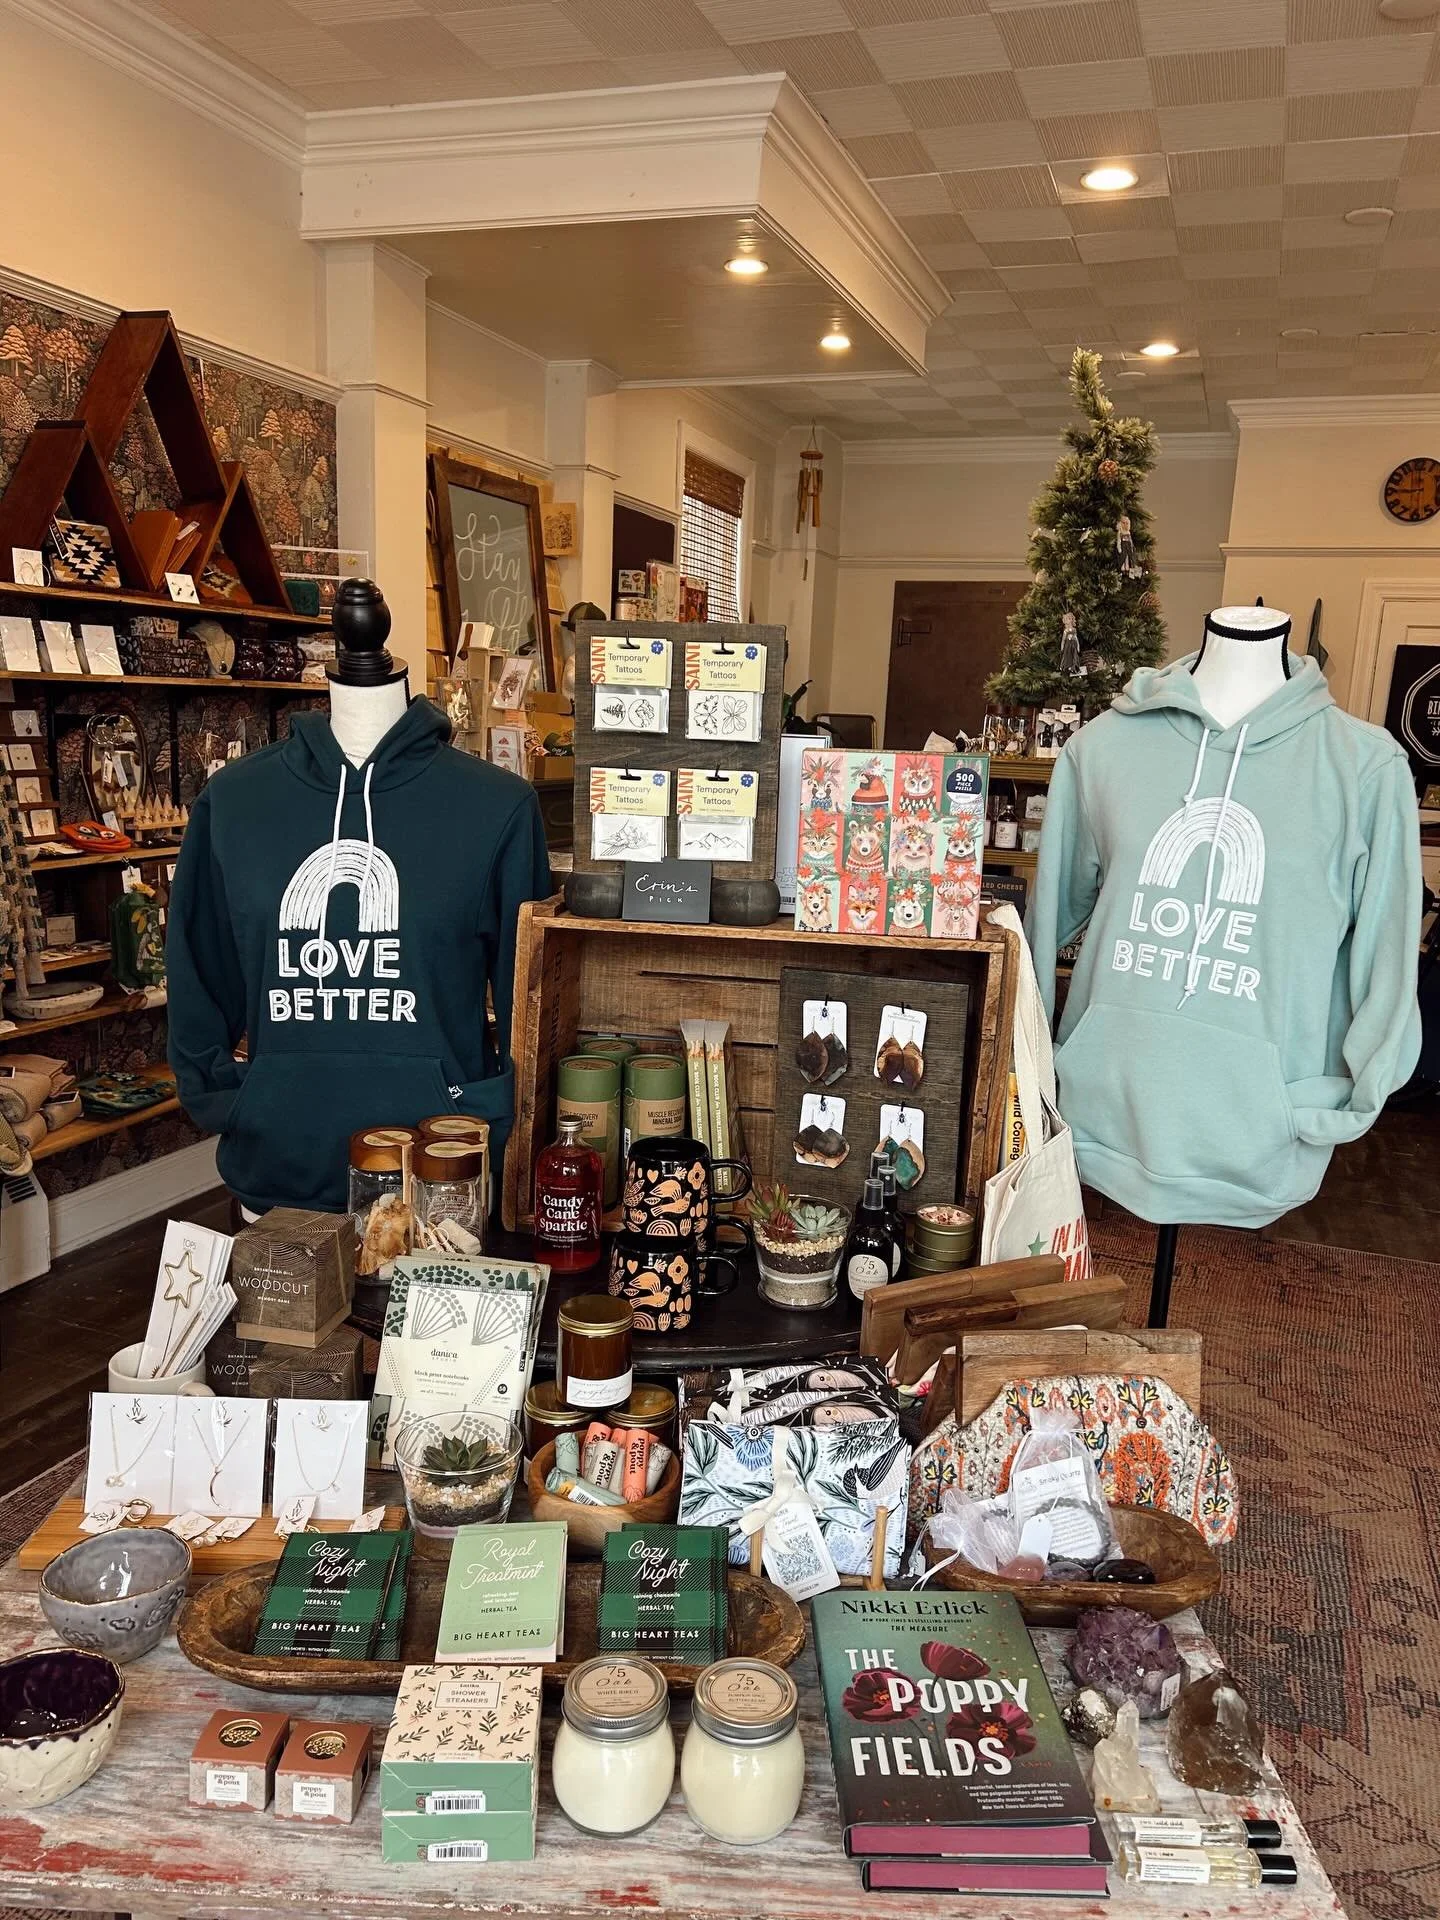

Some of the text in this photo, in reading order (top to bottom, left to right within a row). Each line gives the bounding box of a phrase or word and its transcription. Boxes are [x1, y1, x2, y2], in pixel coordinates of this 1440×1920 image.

[455, 512, 524, 595] Stay
[608, 652, 650, 663] Temporary
[702, 658, 744, 669] Temporary
[615, 664, 643, 674] Tattoos
[709, 670, 737, 680] Tattoos
[955, 773, 975, 782] 500
[608, 783, 651, 795] Temporary
[696, 784, 739, 796] Temporary
[615, 795, 644, 805] Tattoos
[702, 796, 732, 806] Tattoos
[635, 873, 698, 893] Erin's
[996, 881, 1024, 891] CHEESE
[649, 895, 683, 903] PICK
[1128, 891, 1257, 954] LOVE
[278, 938, 400, 979] LOVE
[1111, 939, 1261, 1001] BETTER
[268, 987, 417, 1023] BETTER
[647, 1110, 667, 1118] MUSCLE
[652, 1117, 673, 1125] MINERAL
[543, 1194, 584, 1210] Candy
[546, 1207, 580, 1220] Cane
[539, 1217, 588, 1233] Sparkle
[861, 1256, 875, 1270] 75
[238, 1276, 309, 1295] WOODCUT
[430, 1348, 458, 1359] danica
[414, 1369, 428, 1377] block
[442, 1373, 470, 1381] notebooks
[604, 1450, 617, 1483] poppy
[307, 1540, 350, 1562] Cozy
[483, 1537, 537, 1568] Royal
[627, 1539, 670, 1565] Cozy
[305, 1557, 368, 1584] Night
[631, 1558, 692, 1588] Night
[638, 1604, 662, 1612] HERBAL
[841, 1600, 990, 1616] Nikki Erlick
[271, 1622, 291, 1630] BIG
[294, 1623, 331, 1632] HEART
[453, 1632, 472, 1641] BIG
[476, 1630, 512, 1640] HEART
[634, 1630, 669, 1639] HEART
[844, 1649, 898, 1671] THE
[606, 1665, 626, 1678] 75
[596, 1678, 632, 1687] Oak
[736, 1673, 755, 1685] 75
[727, 1683, 761, 1691] Oak
[887, 1678, 1029, 1713] POPPY
[850, 1737, 1012, 1777] FIELDS
[213, 1773, 236, 1781] poppy
[300, 1785, 323, 1793] poppy
